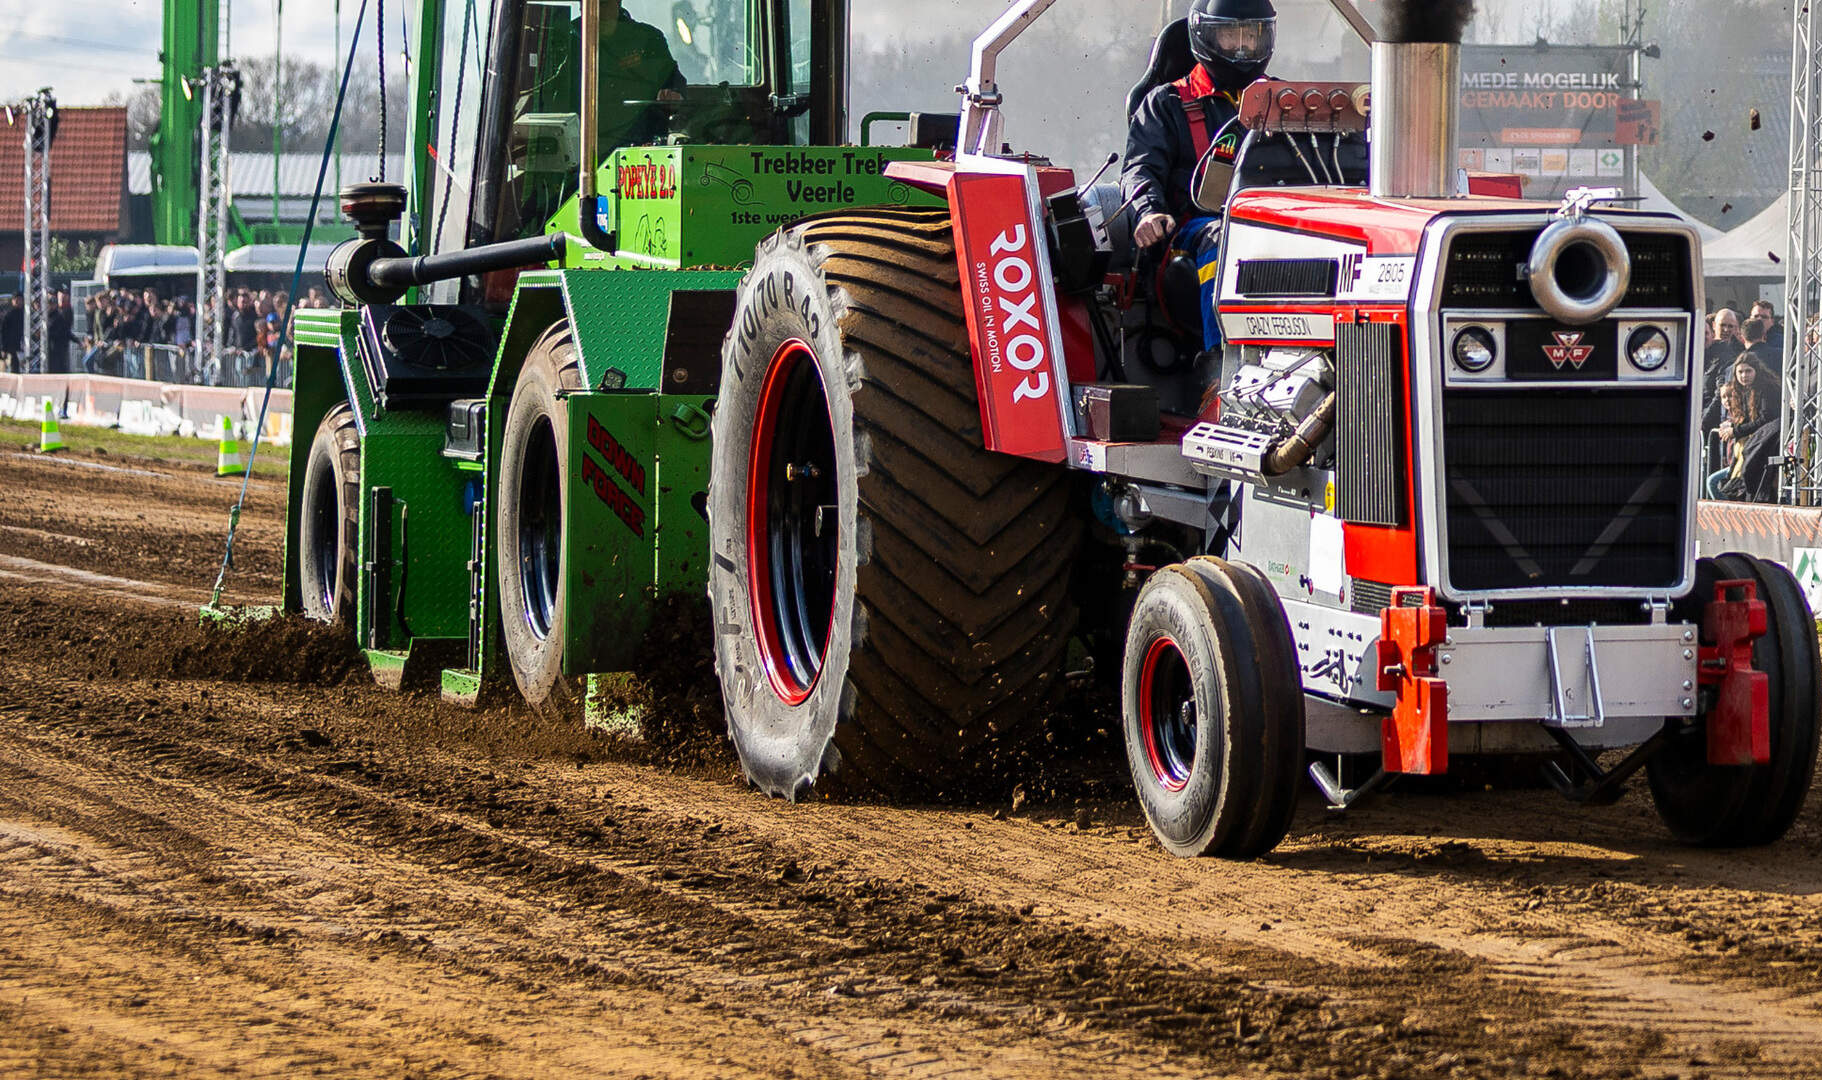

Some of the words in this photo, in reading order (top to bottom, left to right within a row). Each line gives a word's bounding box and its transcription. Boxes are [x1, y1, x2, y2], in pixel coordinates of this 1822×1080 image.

[1462, 72, 1518, 89] MEDE
[1523, 72, 1620, 89] MOGELIJK
[1462, 92, 1557, 109] GEMAAKT
[1563, 92, 1619, 109] DOOR
[617, 157, 658, 200] POPEYE
[659, 164, 676, 199] 2.0
[751, 151, 837, 175] Trekker
[786, 180, 855, 203] Veerle
[731, 210, 761, 225] 1ste
[976, 262, 991, 294] SWISS
[1339, 253, 1364, 294] MF
[1377, 263, 1406, 283] 2805
[783, 270, 796, 313] R
[982, 296, 993, 313] OIL
[984, 315, 996, 327] IN
[990, 223, 1050, 405] ROXOR
[986, 330, 1003, 374] MOTION
[587, 410, 646, 499] DOWN
[581, 450, 646, 542] FORCE
